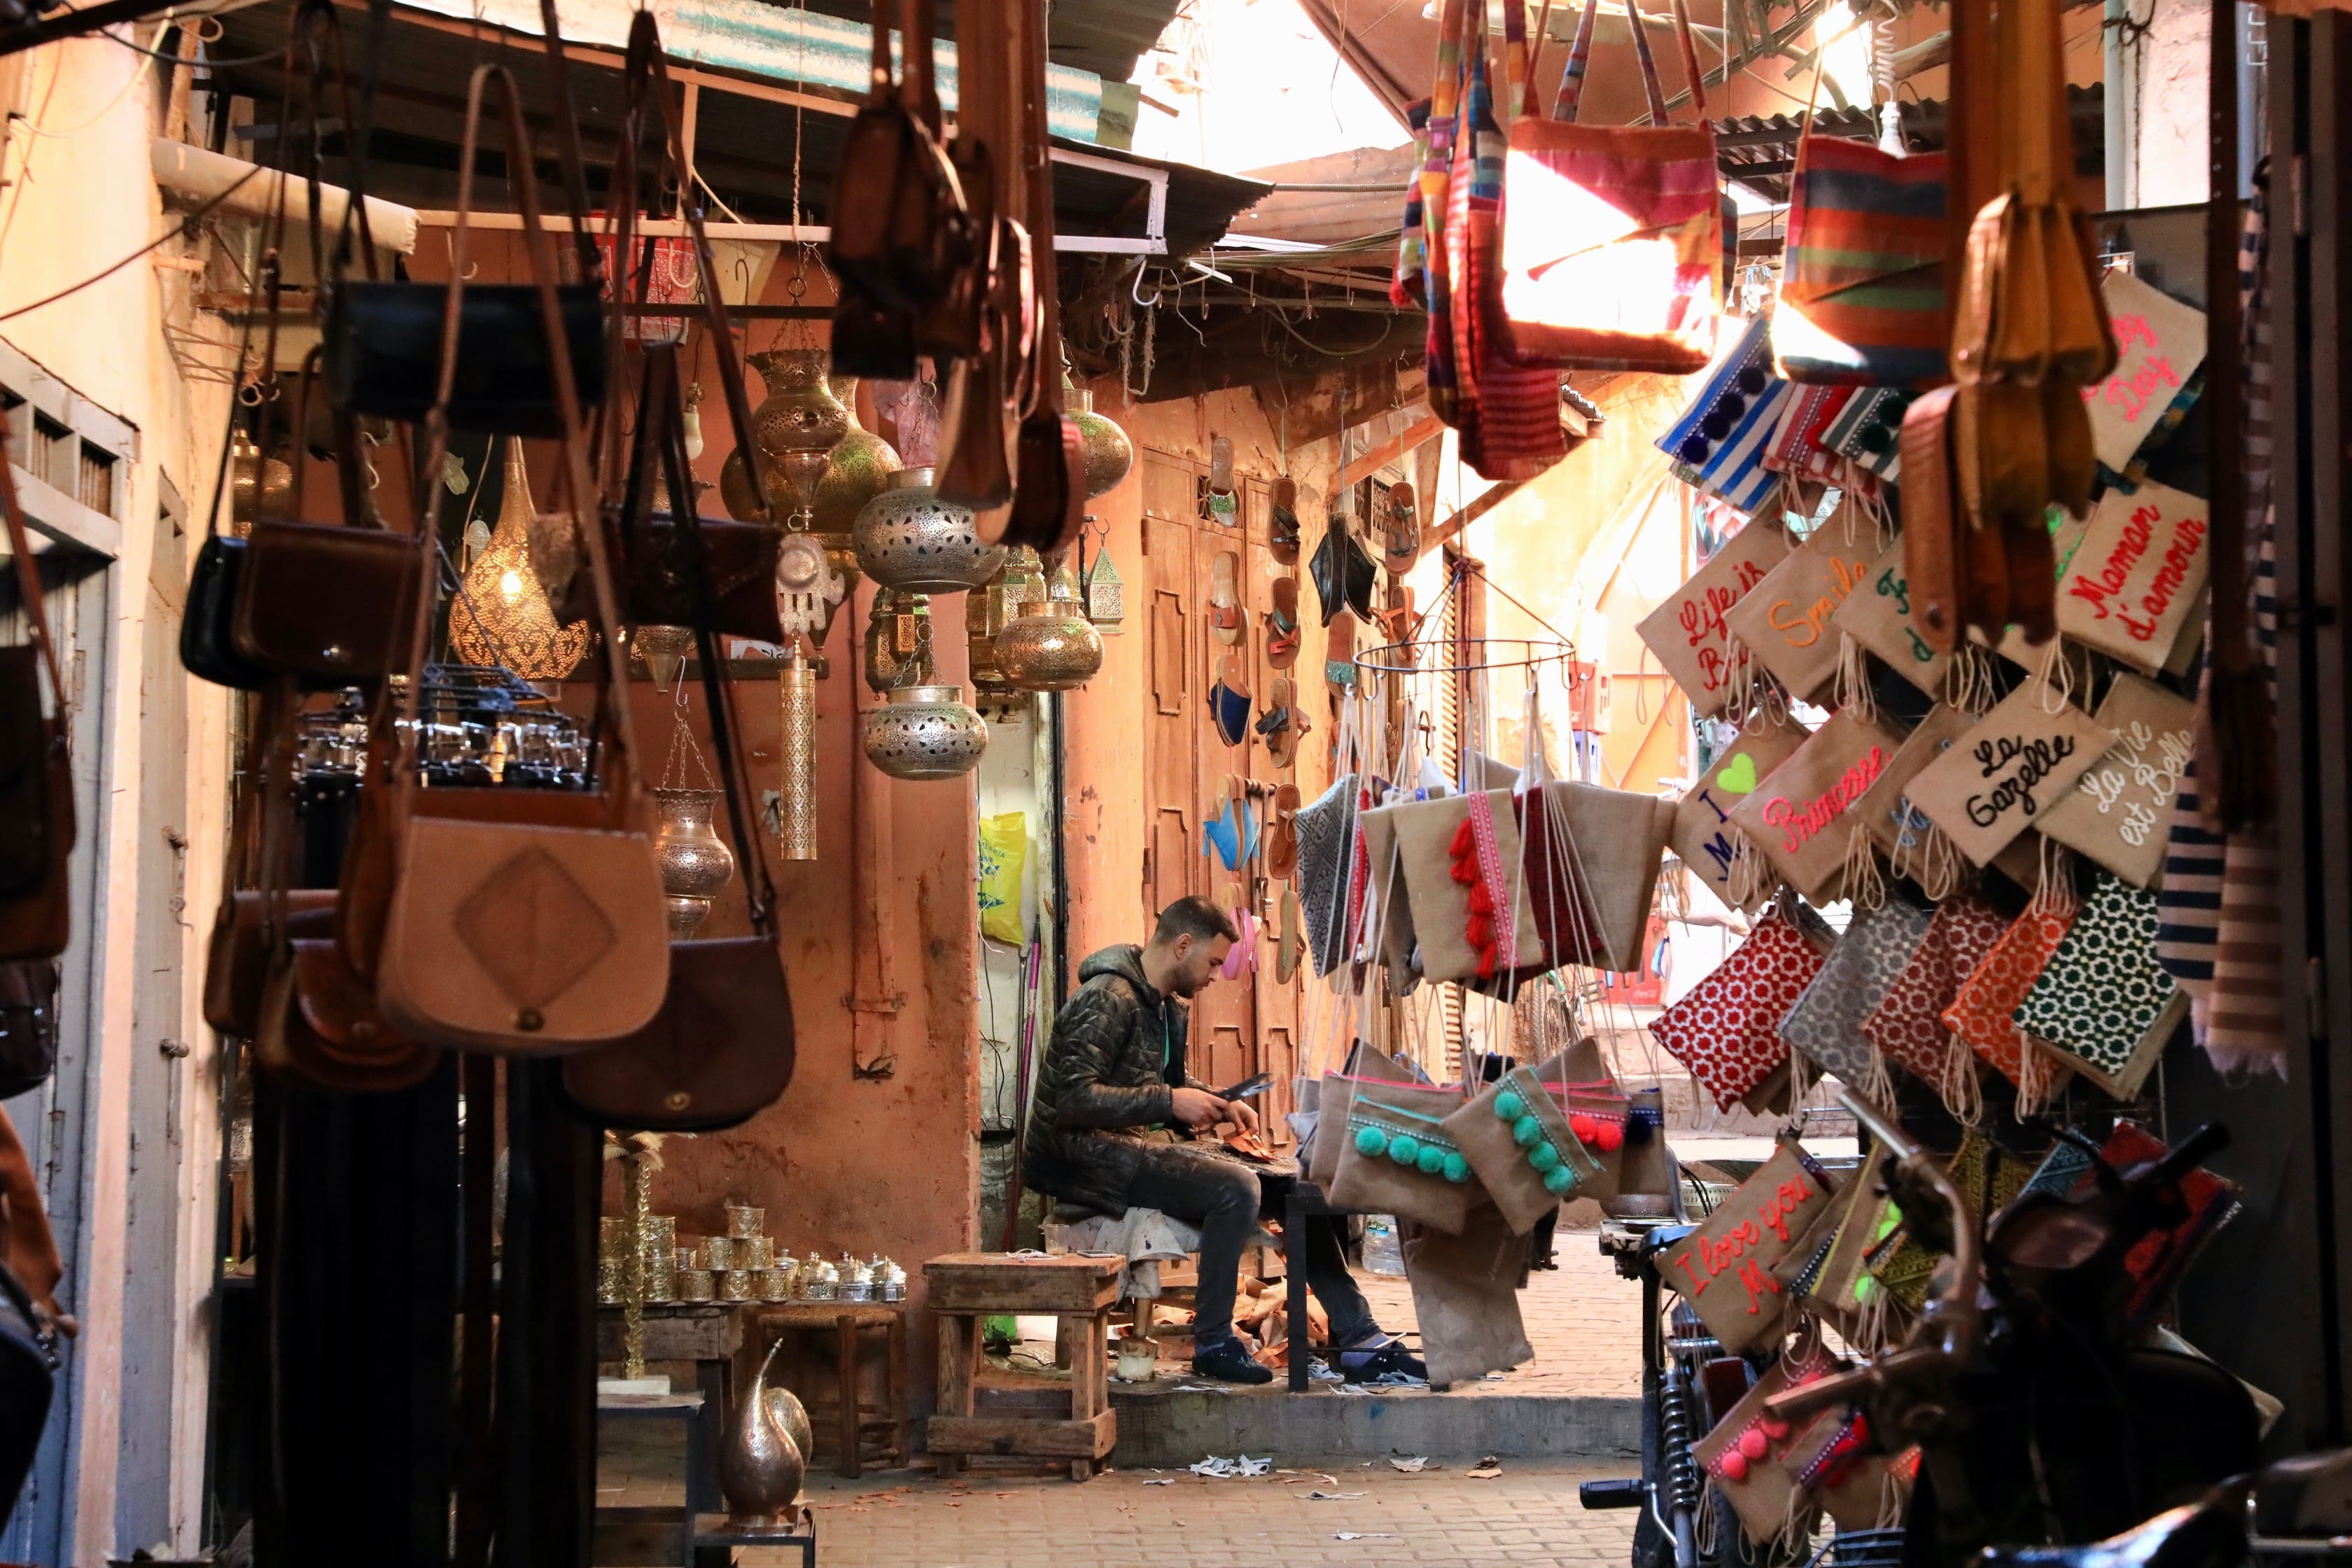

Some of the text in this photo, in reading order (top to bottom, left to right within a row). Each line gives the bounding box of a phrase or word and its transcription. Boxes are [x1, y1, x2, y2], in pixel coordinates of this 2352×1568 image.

[2106, 356, 2181, 423] Day
[2068, 504, 2162, 620] Maman
[2115, 519, 2207, 642] d'amour
[1679, 586, 1737, 648] Life
[1762, 745, 1893, 854] Princess
[1966, 735, 2075, 827] Gazelle
[1973, 734, 2022, 778] La
[2079, 720, 2153, 814] La Vie
[2119, 801, 2157, 848] est
[1674, 1173, 1814, 1296] I love you
